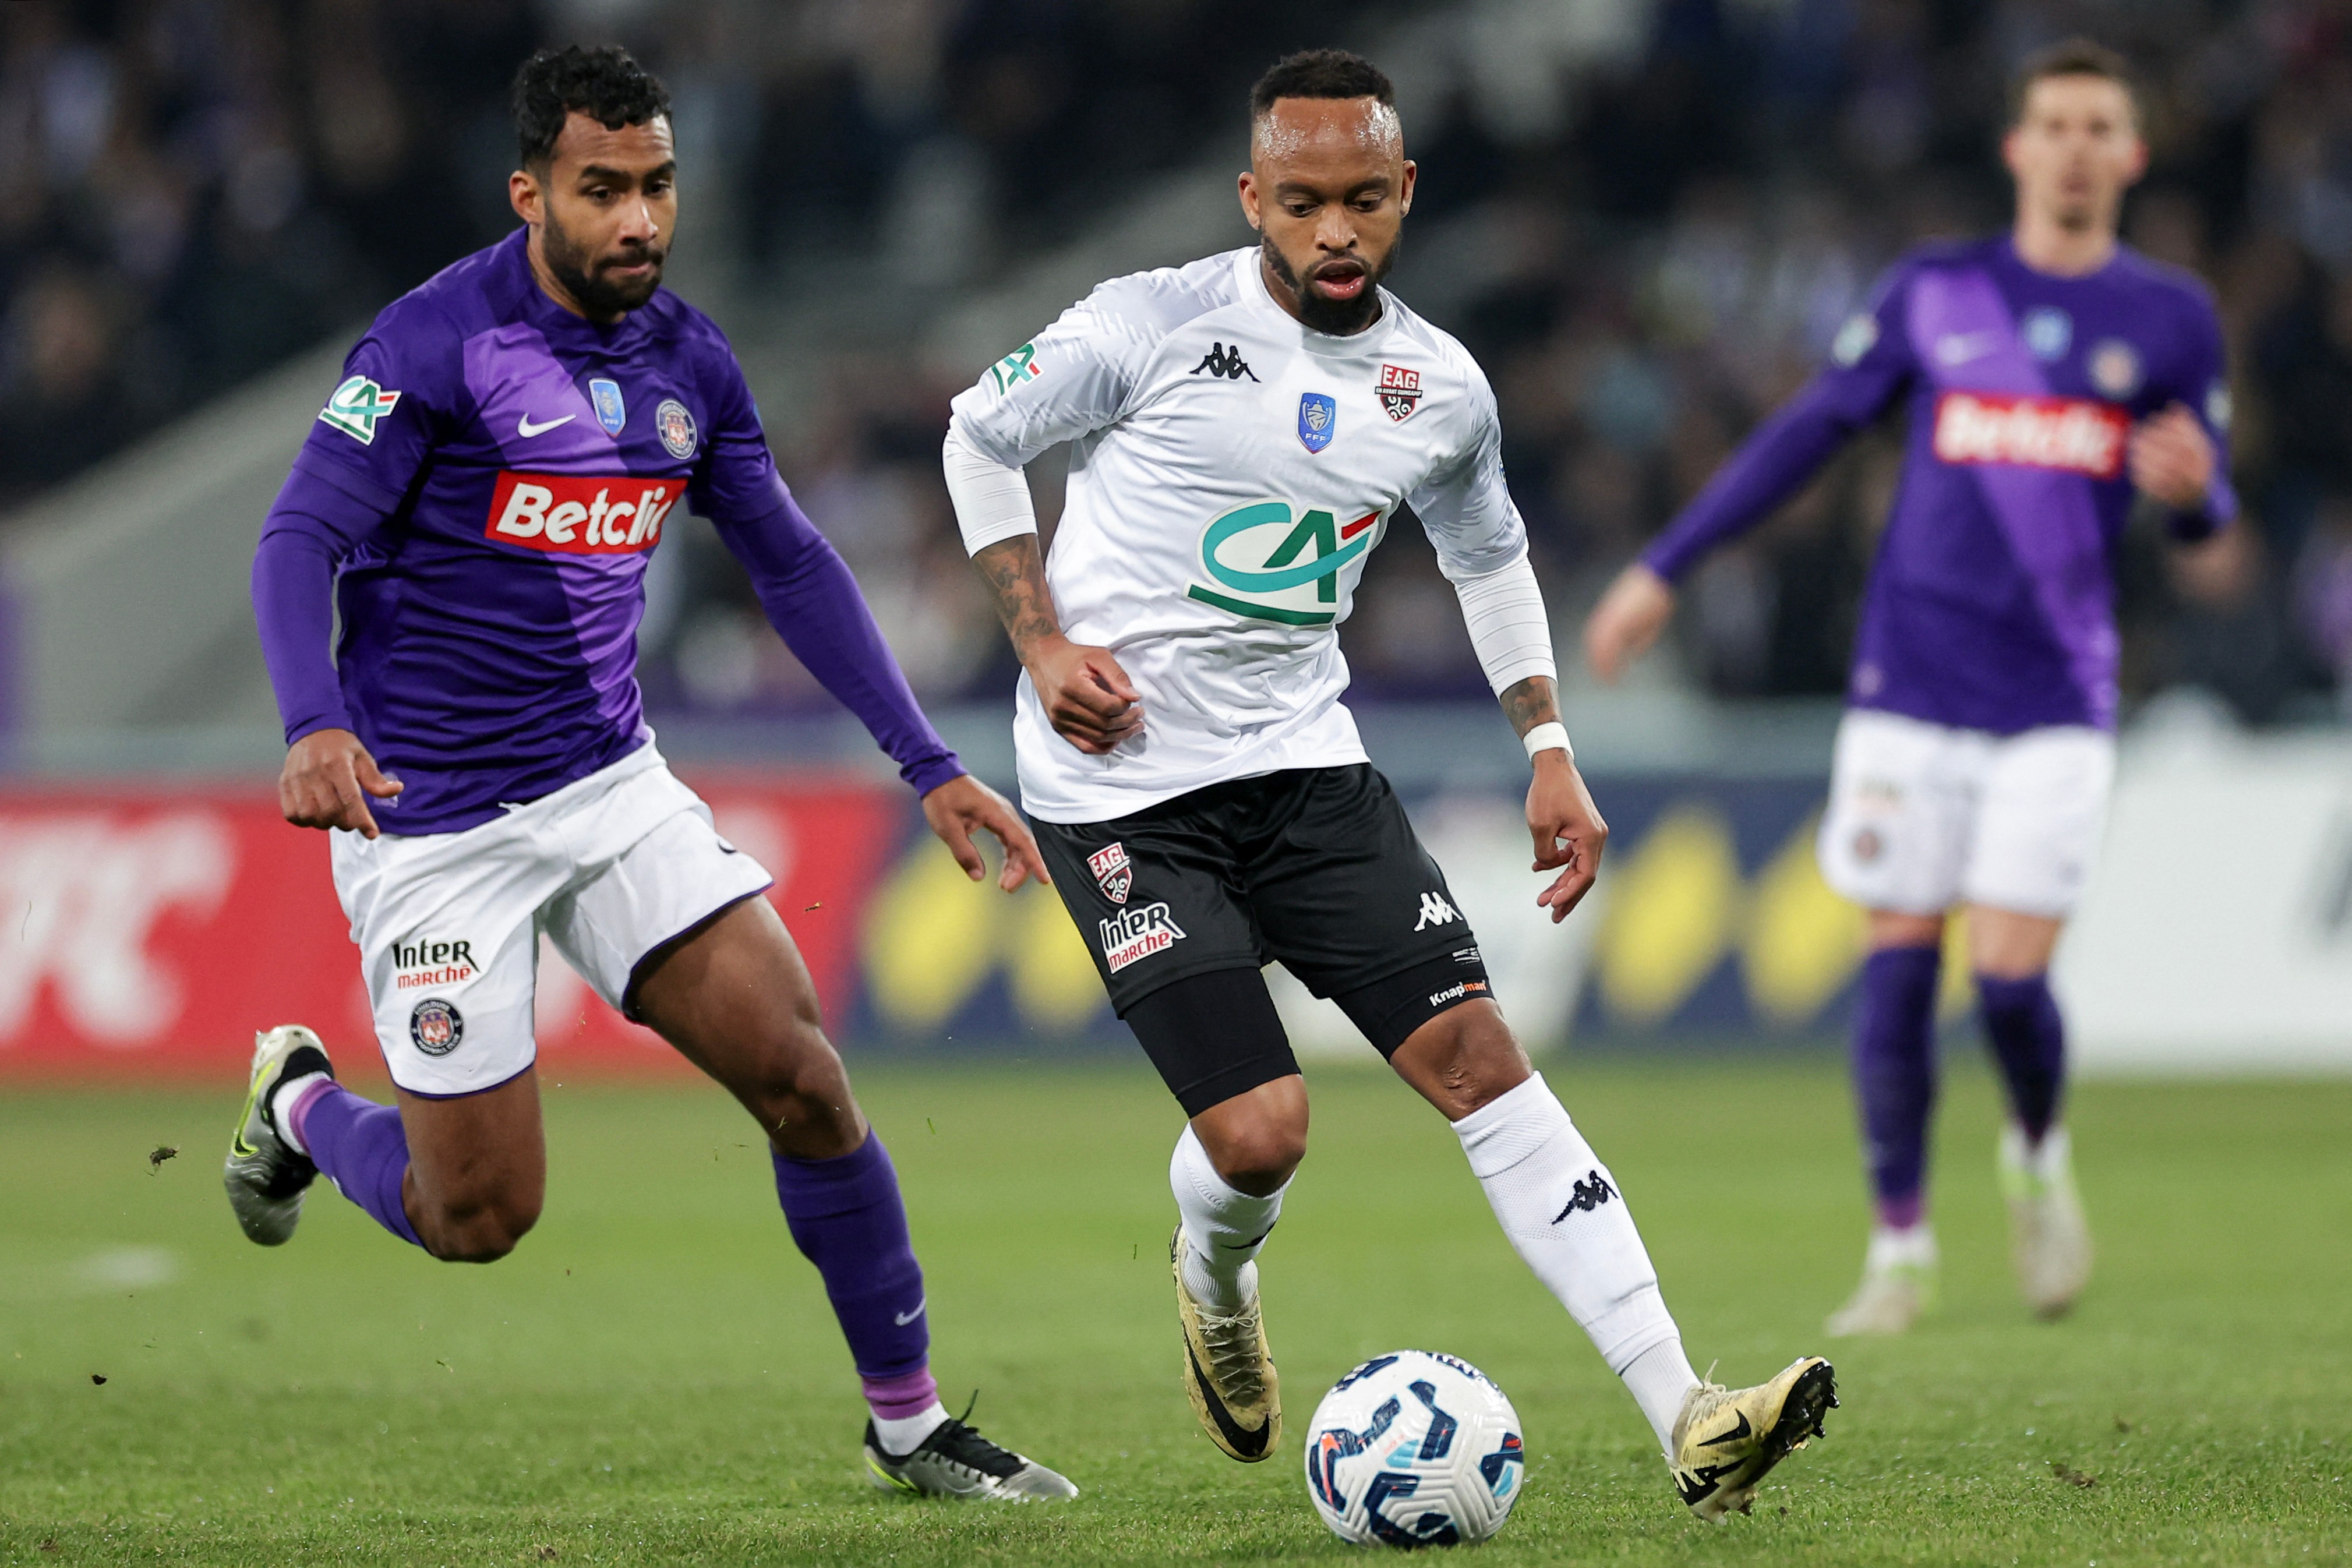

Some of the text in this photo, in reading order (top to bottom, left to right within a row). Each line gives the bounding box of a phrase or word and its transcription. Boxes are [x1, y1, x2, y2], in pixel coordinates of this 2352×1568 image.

[1382, 366, 1417, 389] EAG
[1305, 433, 1326, 442] FFF
[1091, 847, 1122, 877] EAG
